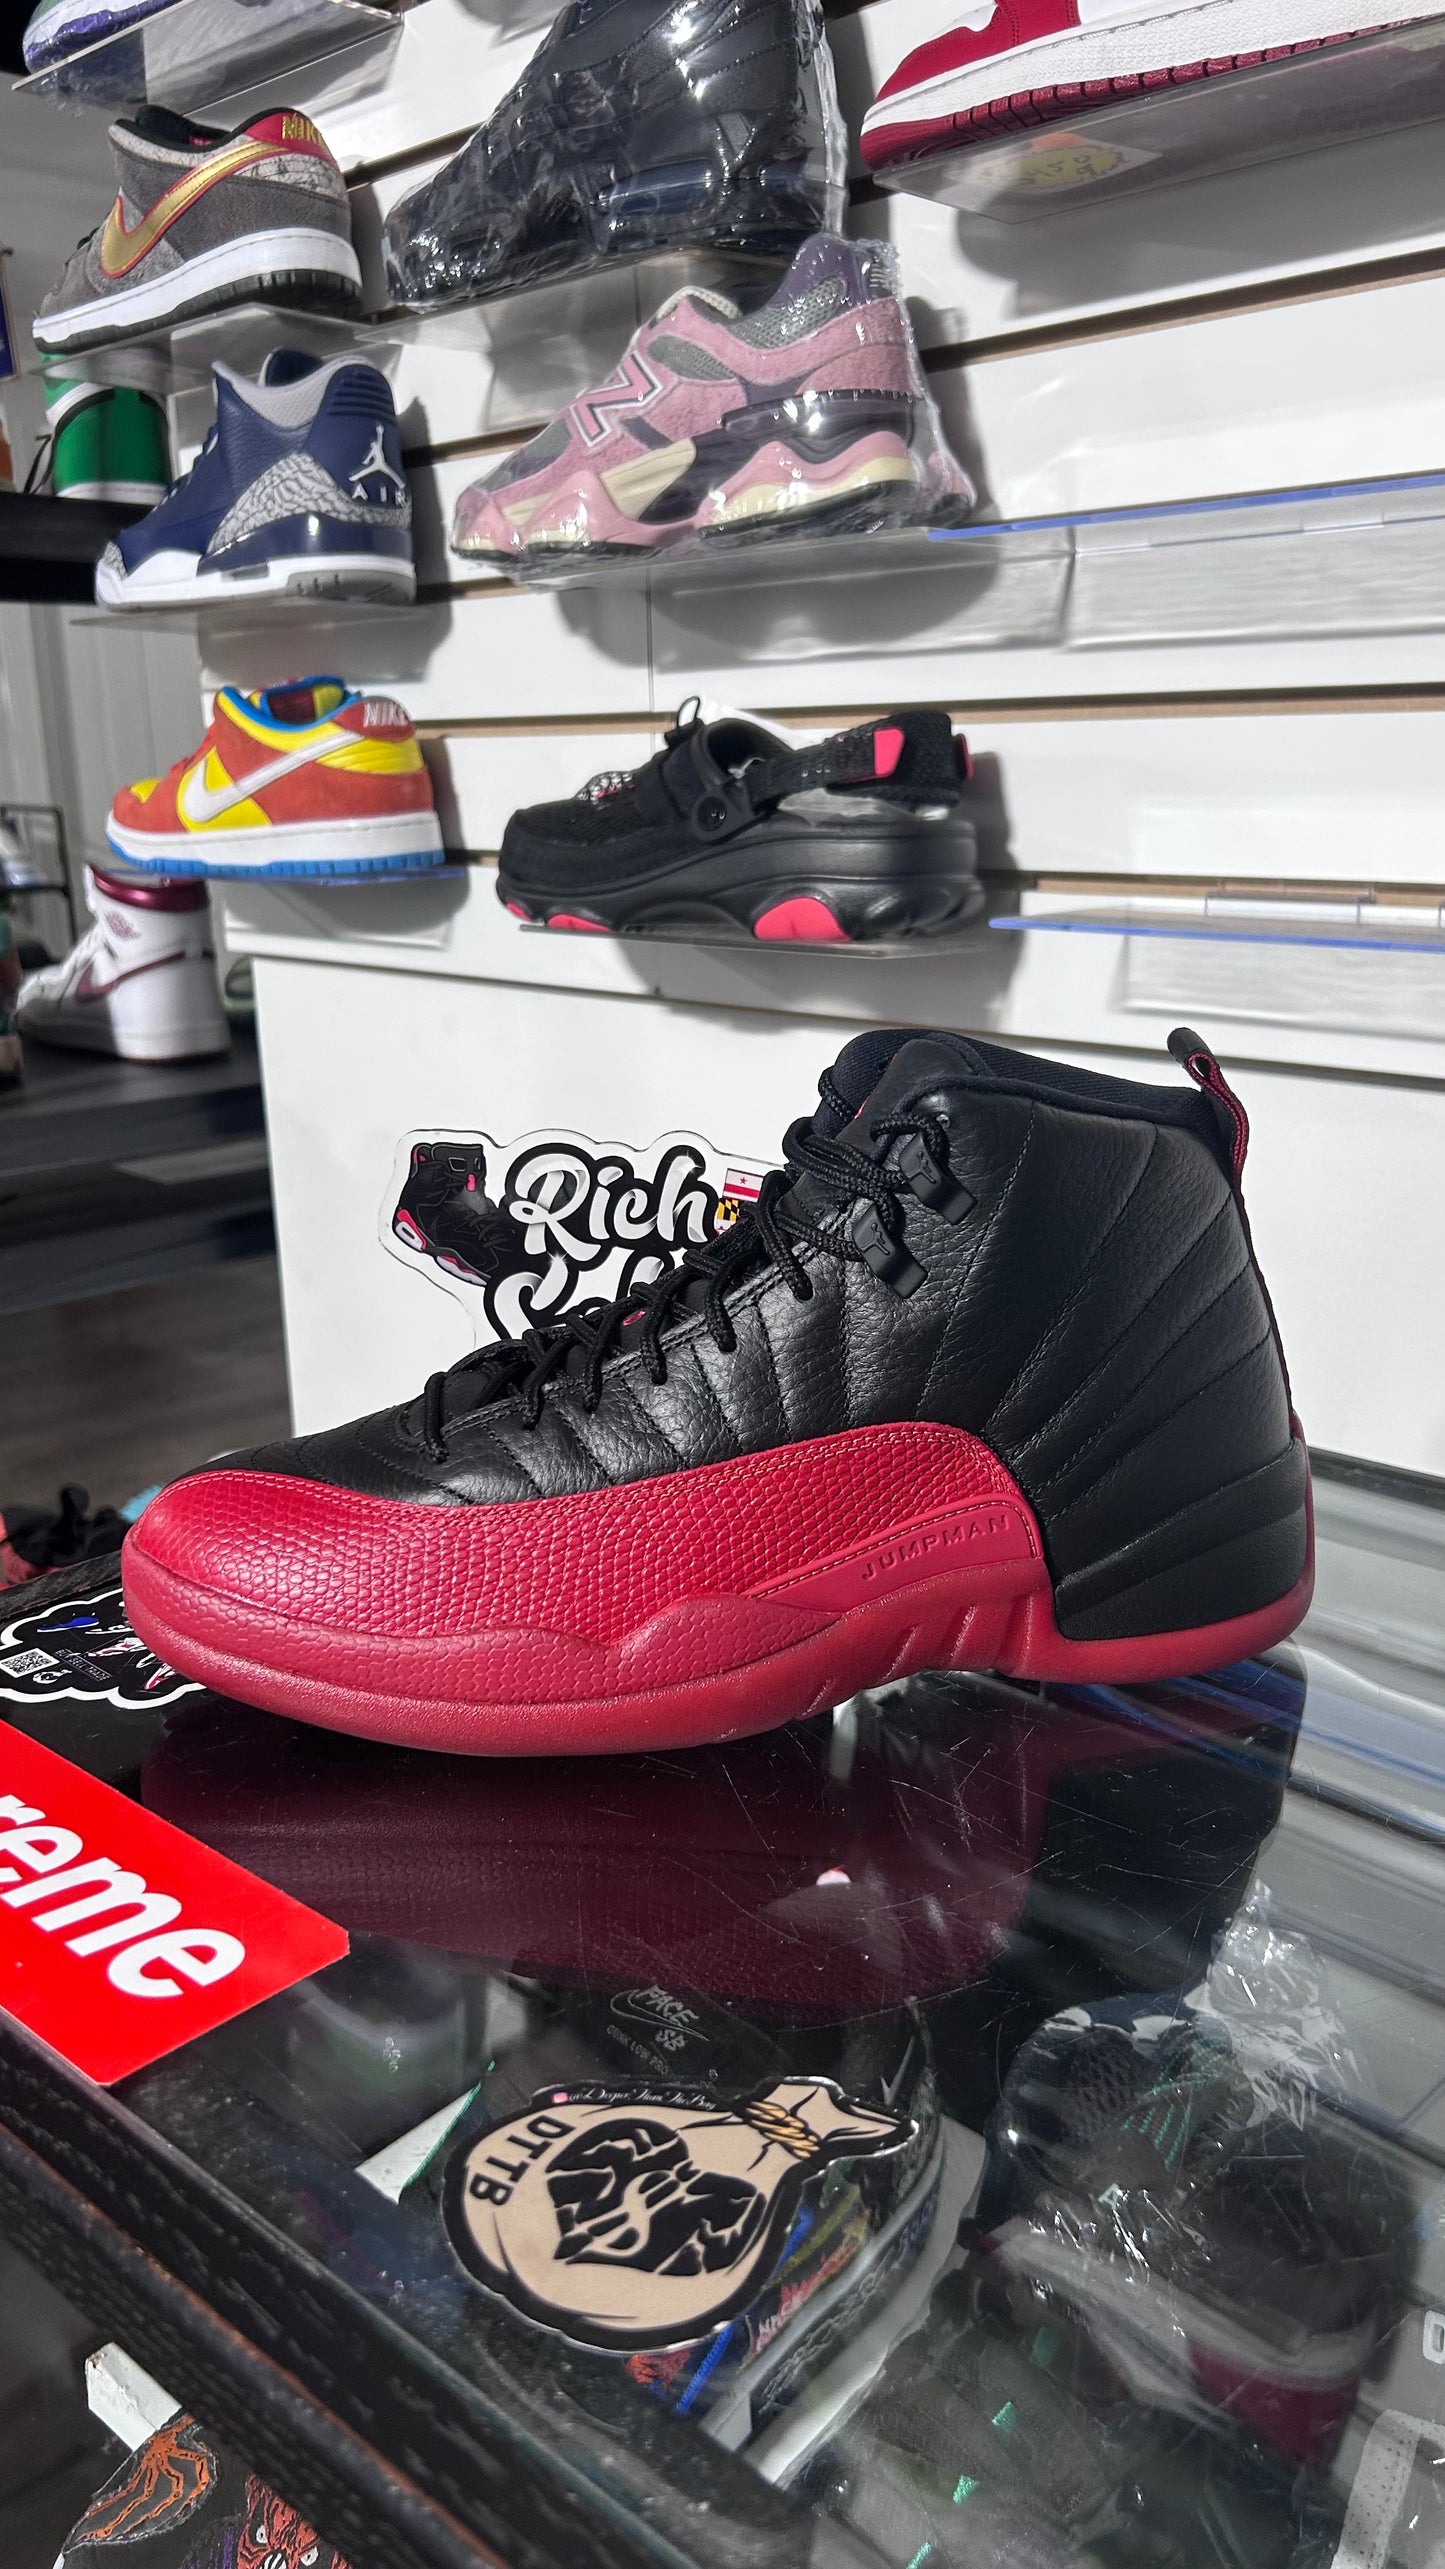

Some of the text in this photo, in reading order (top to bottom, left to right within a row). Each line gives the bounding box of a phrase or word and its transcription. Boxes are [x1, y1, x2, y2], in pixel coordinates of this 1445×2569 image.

[507, 1151, 710, 1263] Rich
[861, 1513, 1011, 1582] JUMPMAN
[468, 2114, 577, 2206] DTTB
